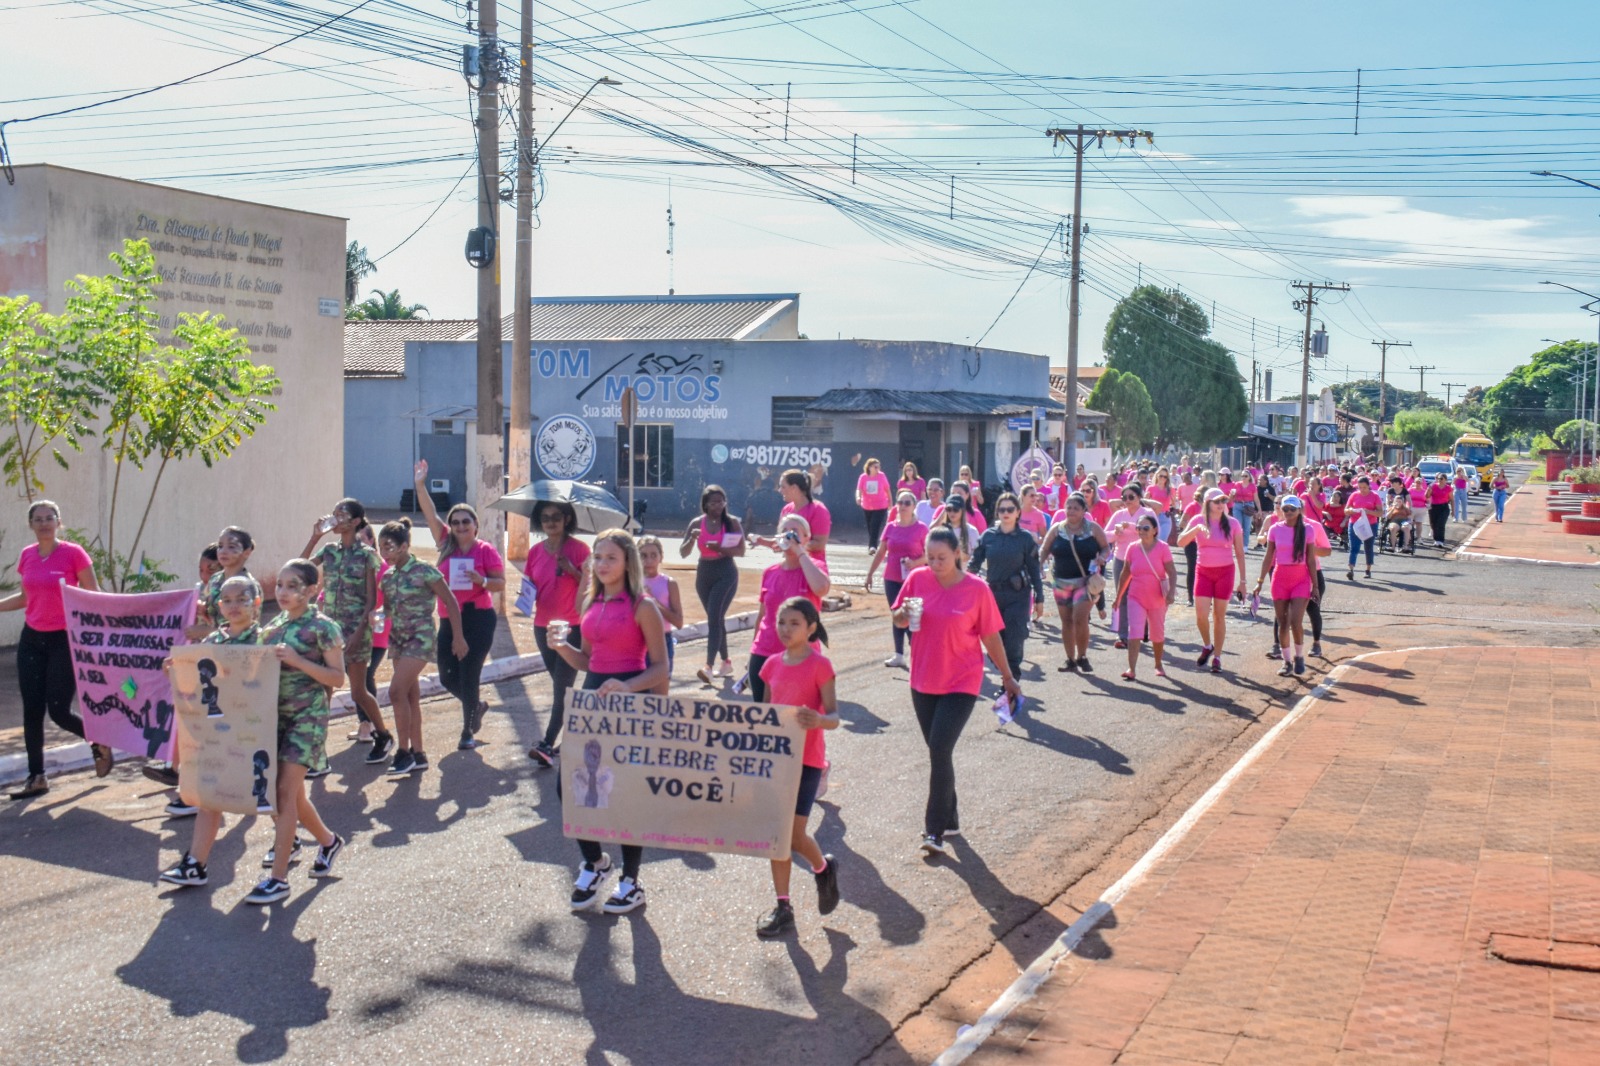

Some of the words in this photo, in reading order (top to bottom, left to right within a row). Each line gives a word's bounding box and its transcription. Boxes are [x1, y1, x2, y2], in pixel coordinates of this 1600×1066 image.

[136, 214, 160, 234] Dra.
[212, 226, 223, 242] de
[225, 228, 250, 247] Paula
[268, 256, 284, 268] 2777
[236, 274, 253, 291] dos
[254, 276, 283, 295] Santos
[603, 374, 722, 403] MOTOS
[582, 404, 600, 418] Sua
[601, 402, 647, 419] satisão
[650, 404, 656, 418] é
[657, 408, 663, 418] o
[665, 408, 690, 419] nosso
[692, 406, 728, 422] objetivo
[549, 421, 564, 434] TOM
[564, 420, 582, 434] MOTOS
[730, 447, 746, 460] (67)
[746, 445, 832, 467] 981773505
[105, 615, 182, 630] ENSINARAM
[80, 631, 104, 646] SER
[107, 633, 174, 651] SUBMISSAS
[87, 670, 108, 685] SER
[571, 690, 636, 713] HONRE
[642, 696, 685, 718] SUA
[567, 715, 655, 738] EXALTE
[661, 720, 702, 743] SEU
[612, 745, 718, 772] CELEBRE
[729, 756, 774, 779] SER
